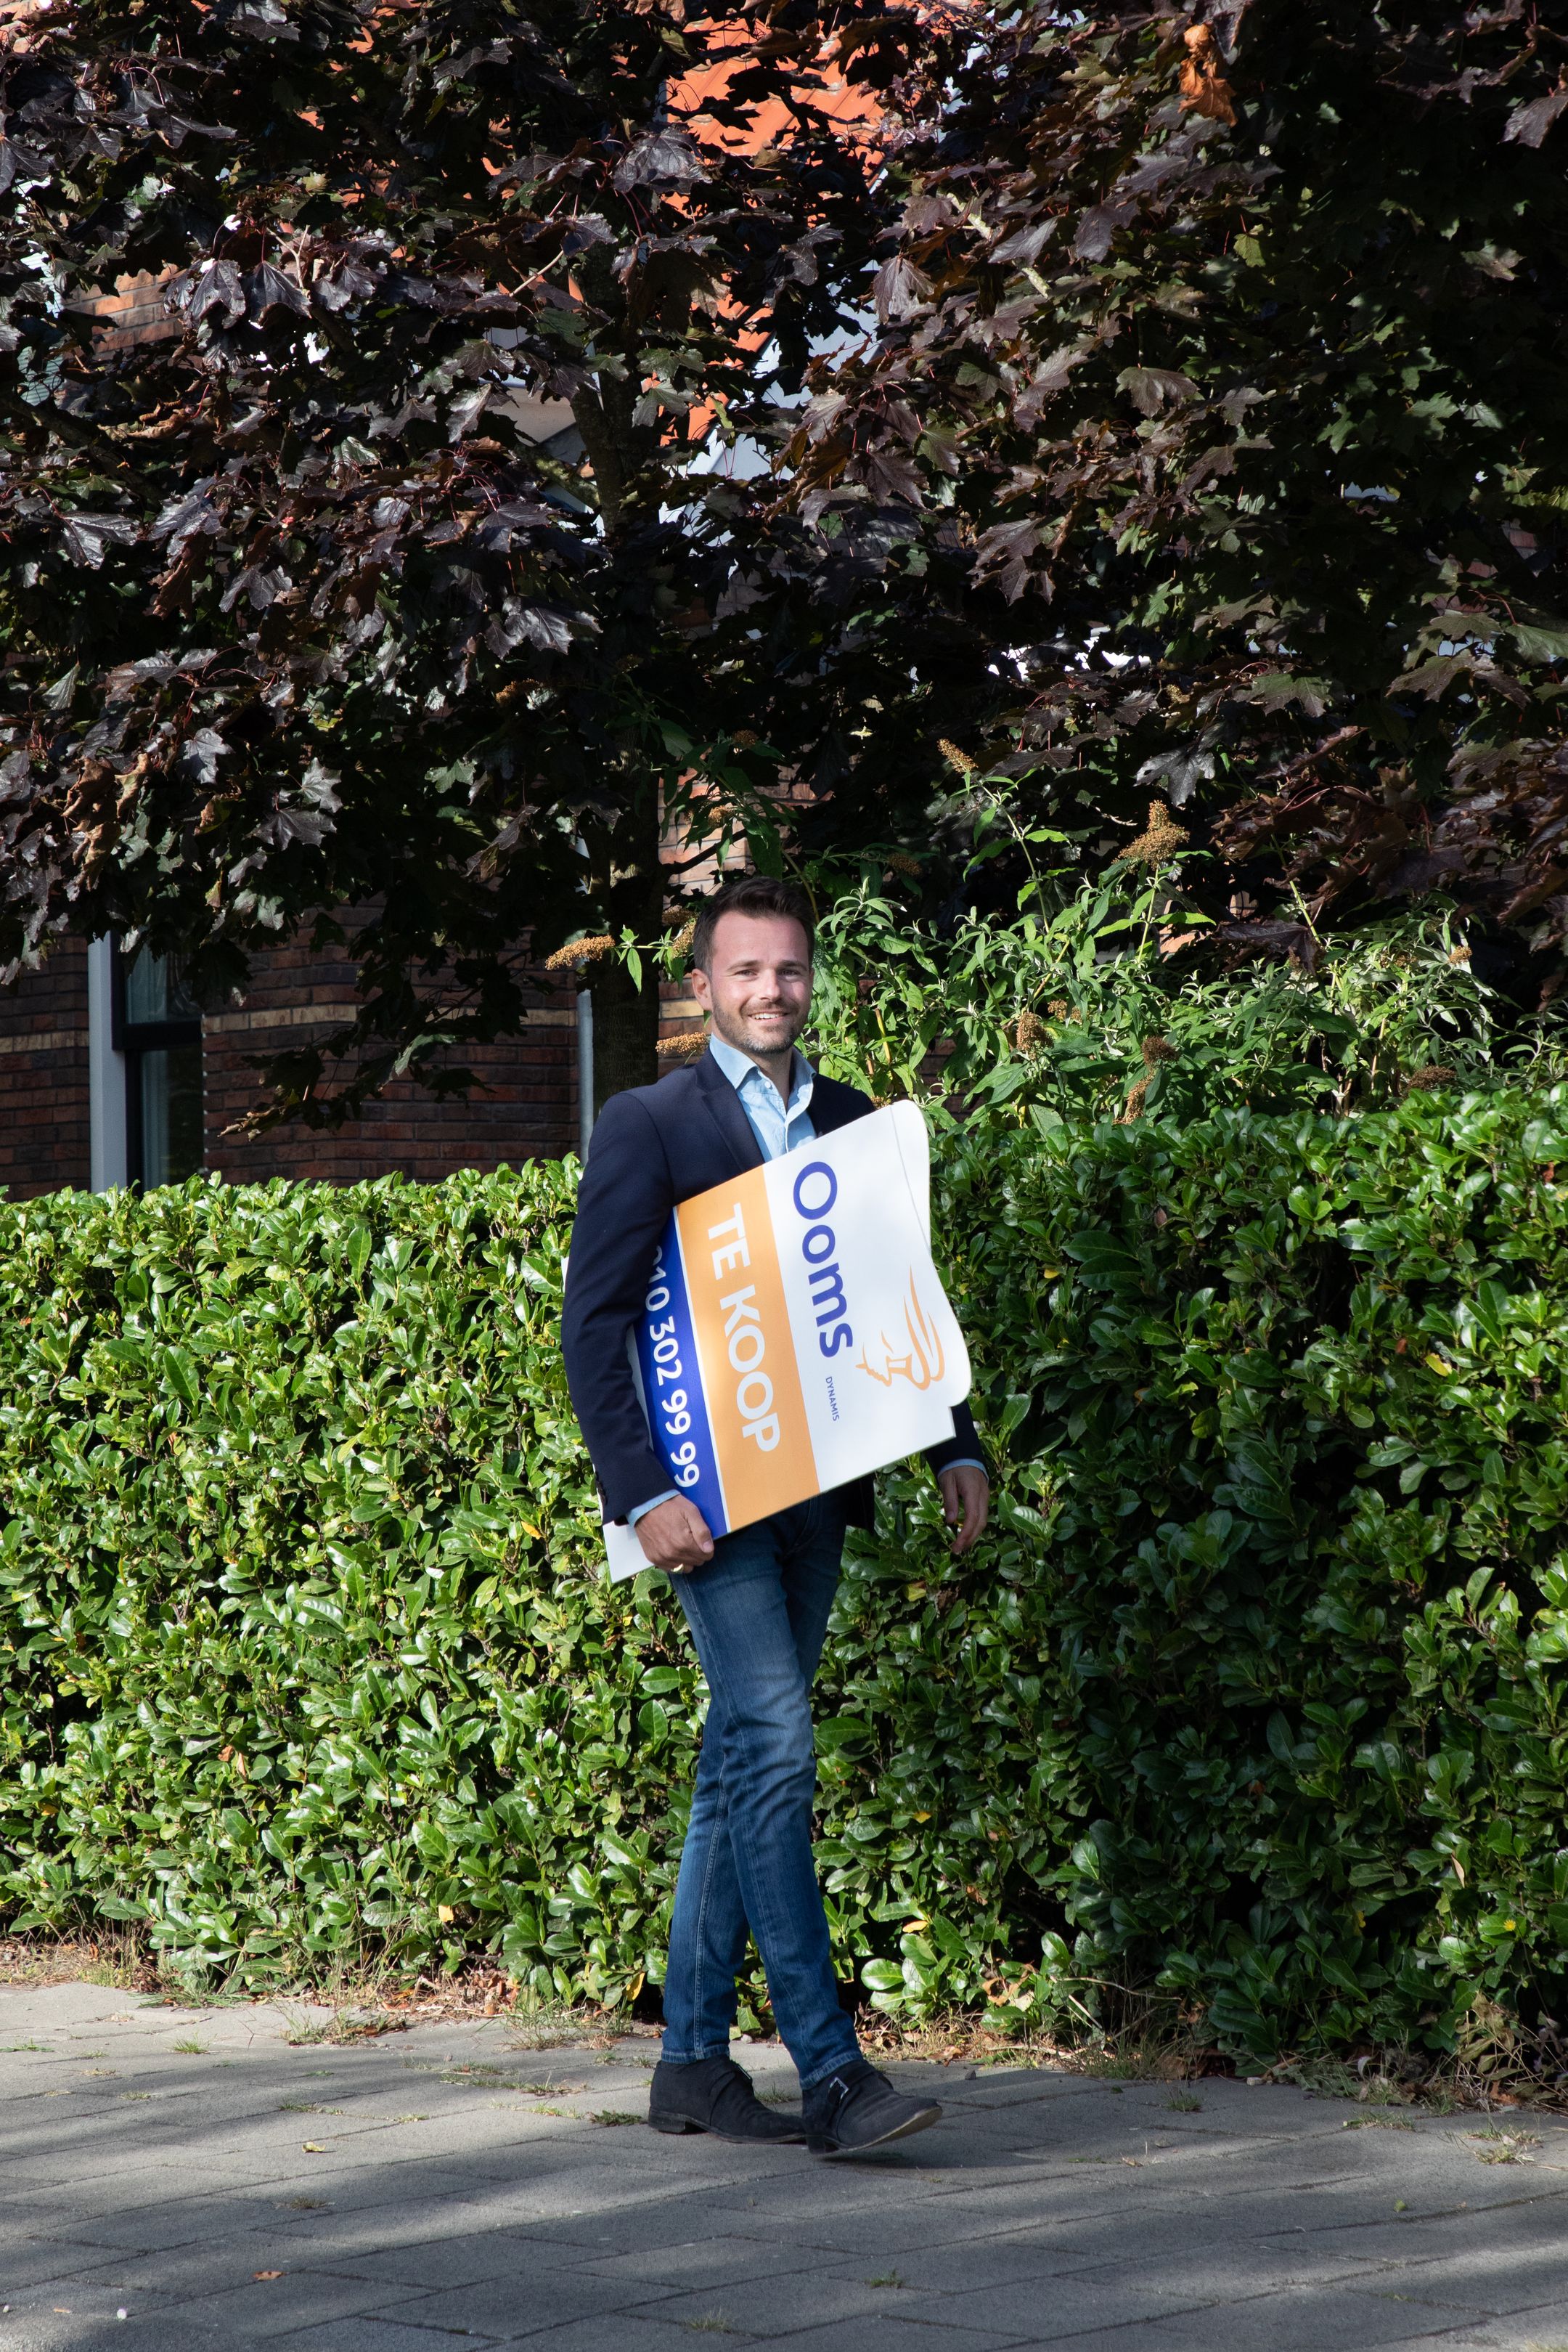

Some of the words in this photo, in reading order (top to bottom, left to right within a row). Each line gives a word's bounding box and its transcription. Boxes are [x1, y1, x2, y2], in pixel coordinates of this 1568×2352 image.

[708, 1202, 751, 1281] TE
[793, 1162, 853, 1358] Ooms
[649, 1315, 684, 1386] 302
[719, 1285, 781, 1452] KOOP
[661, 1388, 692, 1436] 99
[825, 1375, 841, 1423] DYNAMIS
[670, 1441, 700, 1488] 99
